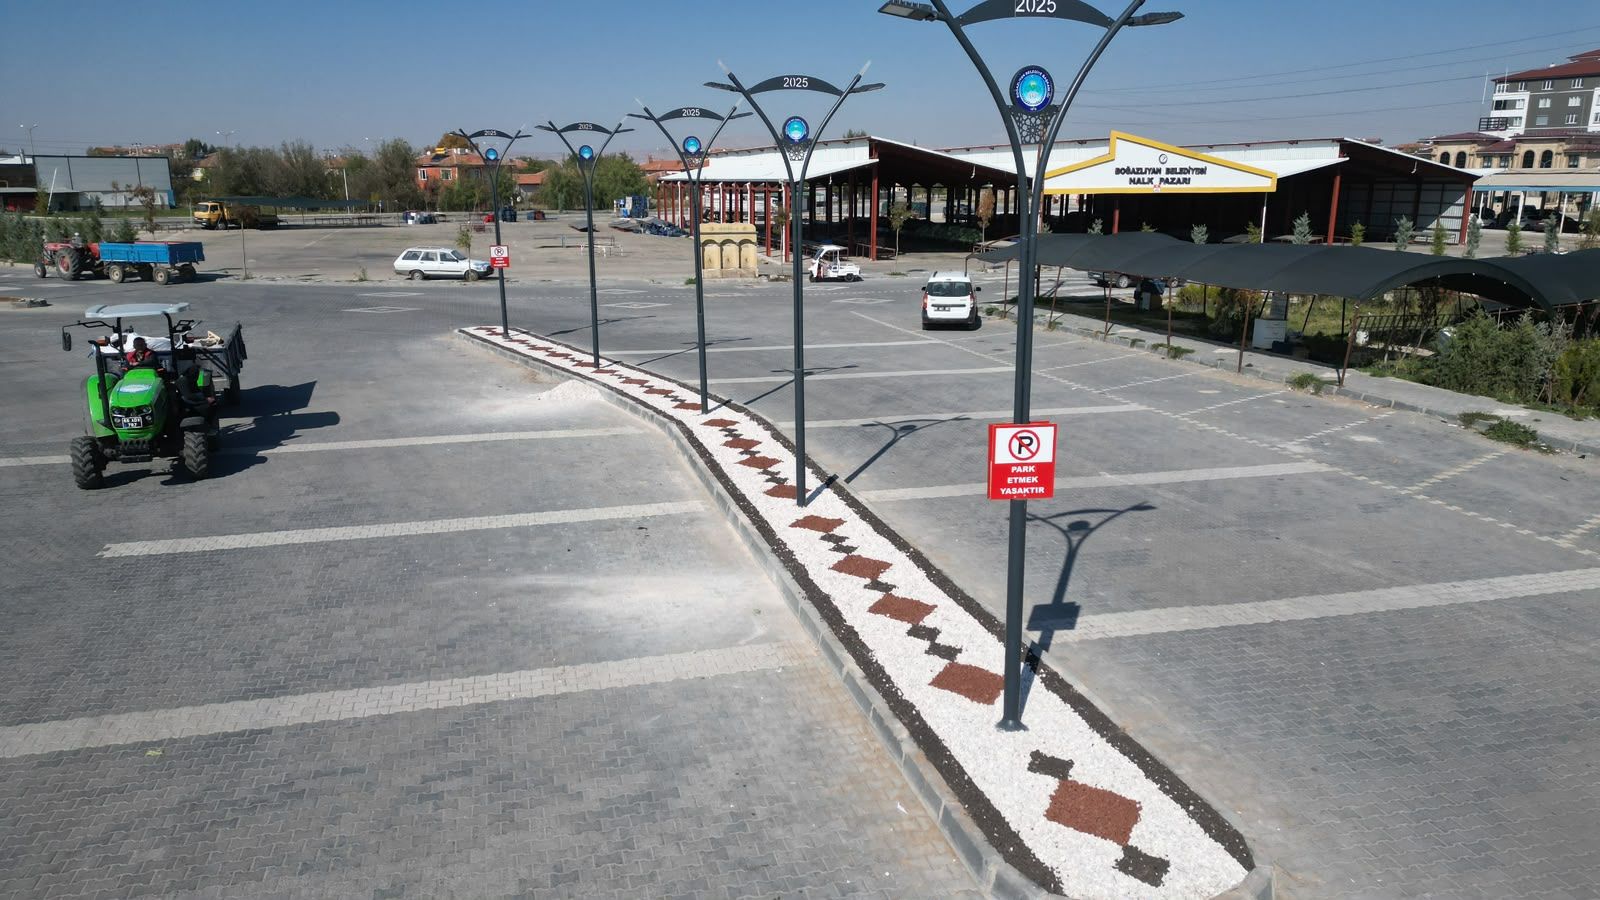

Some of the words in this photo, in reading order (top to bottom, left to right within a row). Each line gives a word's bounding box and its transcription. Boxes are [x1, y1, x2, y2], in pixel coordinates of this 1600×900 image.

[1015, 0, 1057, 13] 2025
[783, 77, 809, 88] 2025
[682, 108, 701, 117] 2025
[1115, 166, 1162, 175] BOĞAZLIYAN
[1129, 177, 1154, 185] HALK
[1159, 177, 1191, 185] PAZARI
[1011, 465, 1036, 473] PARK
[1007, 476, 1039, 484] ETMEK
[1000, 487, 1045, 495] YASAKTIR
